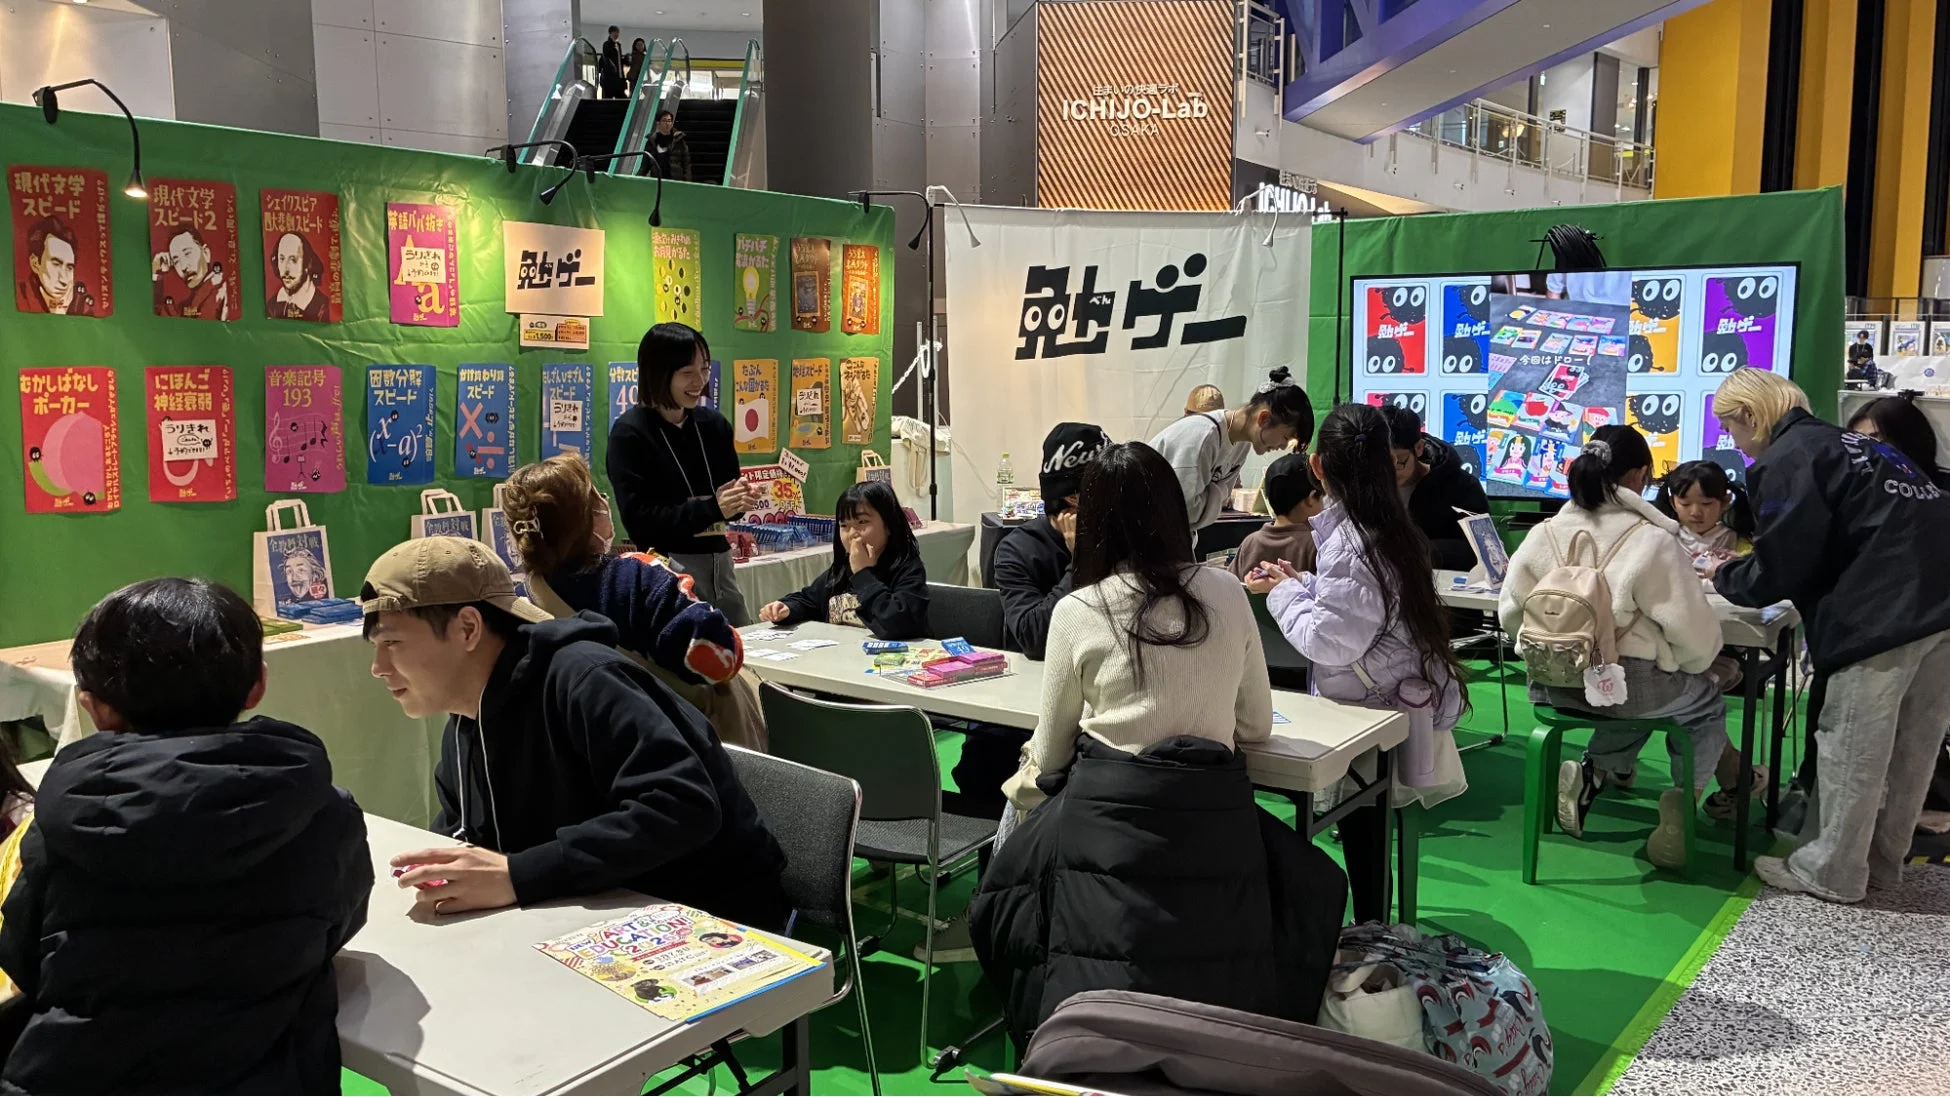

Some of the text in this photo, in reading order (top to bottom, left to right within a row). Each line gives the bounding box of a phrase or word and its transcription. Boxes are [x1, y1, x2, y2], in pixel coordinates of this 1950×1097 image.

[1092, 83, 1180, 96] 住まいの快適ラボ
[1062, 97, 1208, 121] ICHIJO-Lab
[1110, 123, 1160, 137] OSAKA
[14, 172, 85, 196] 現代文学
[153, 185, 215, 209] 現代文学
[267, 194, 317, 212] シェイクスピア
[22, 197, 81, 219] スピード
[154, 207, 217, 230] スピード2
[264, 211, 323, 233] 四大悲劇スピード
[517, 248, 595, 290] 勉ゲー
[1015, 253, 1247, 360] 勉ゲー
[20, 368, 98, 393] むかしばなし
[155, 368, 211, 390] にほんご
[268, 369, 326, 387] 音楽記号
[369, 369, 422, 388] 因数分解
[154, 392, 212, 411] 神経衰弱
[283, 388, 312, 408] 193
[373, 389, 417, 406] スピード
[467, 384, 495, 400] スピード
[550, 384, 576, 400] スピード
[33, 392, 90, 415] ポーカー
[165, 423, 209, 433] うりきれ
[578, 917, 691, 957] EDUCATION!
[603, 922, 637, 939] ART
[569, 940, 592, 951] NEW
[625, 933, 678, 954] 2026
